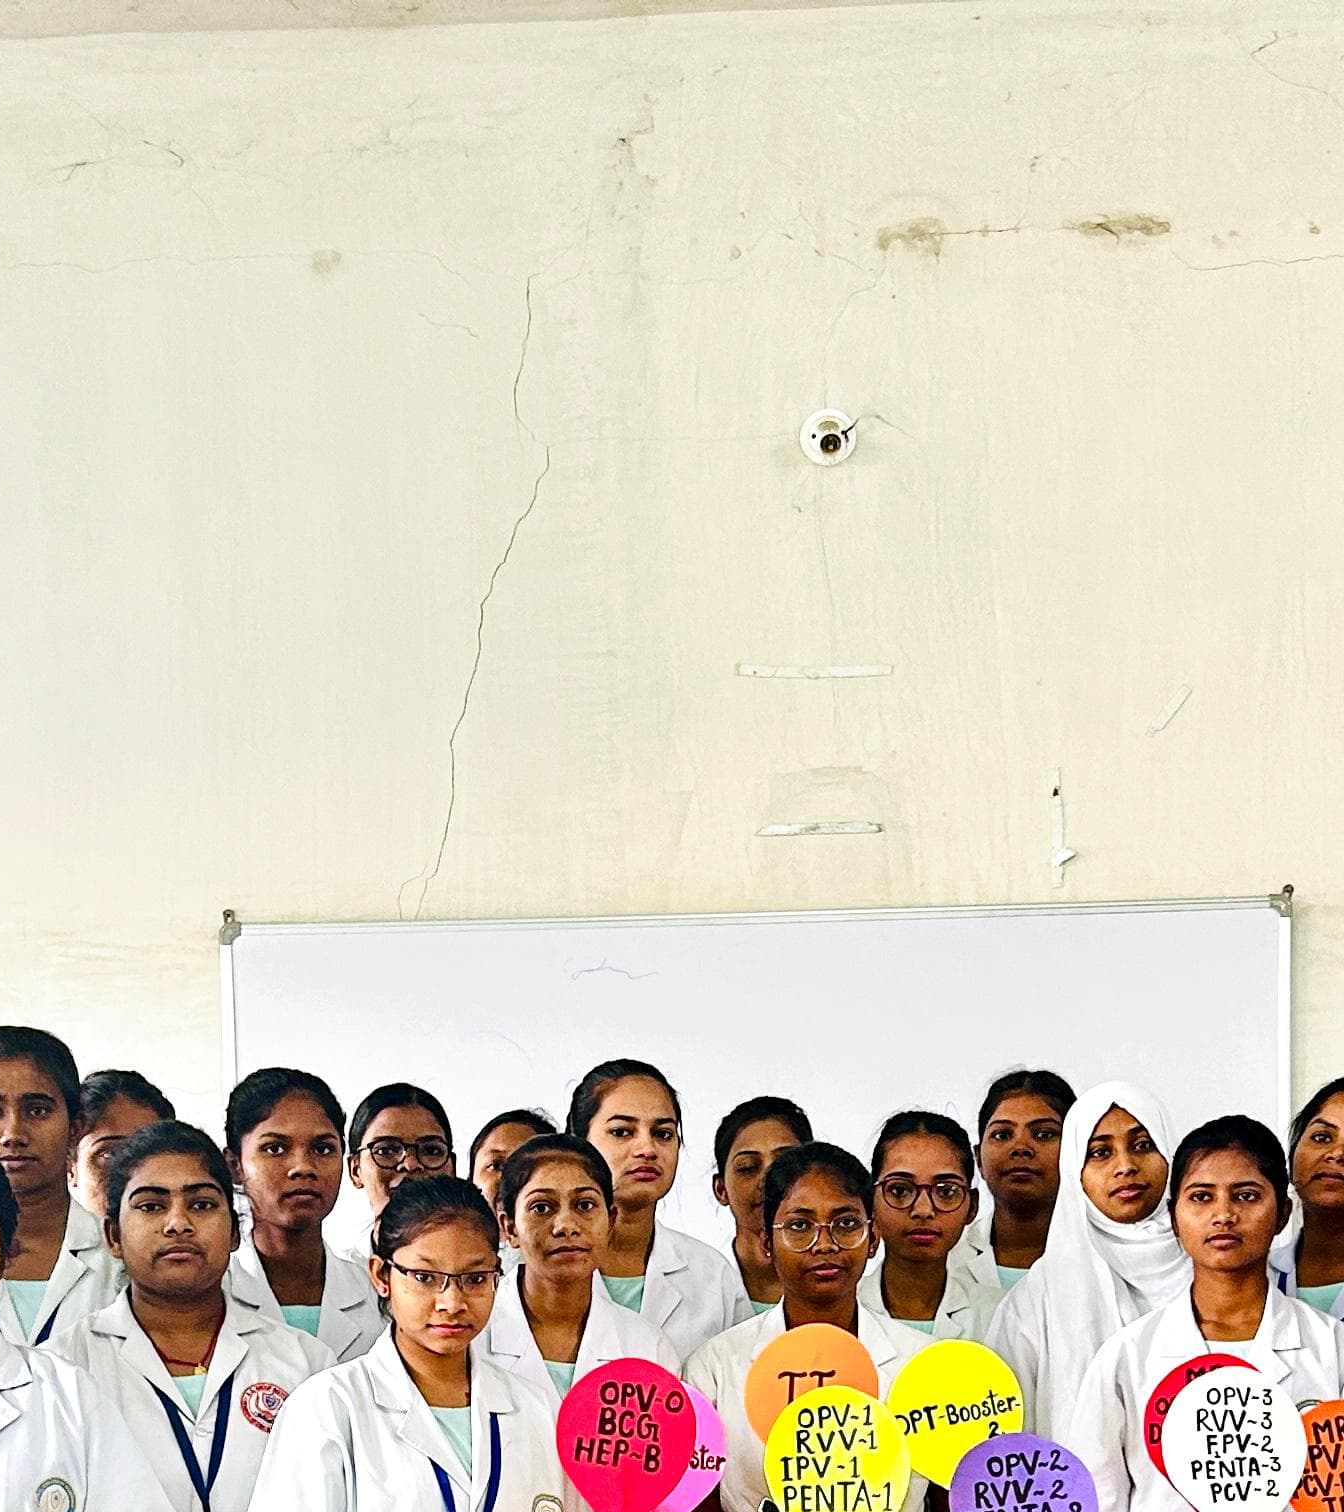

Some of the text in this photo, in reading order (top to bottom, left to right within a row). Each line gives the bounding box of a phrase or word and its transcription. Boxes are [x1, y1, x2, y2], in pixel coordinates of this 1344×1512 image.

[1206, 1386, 1272, 1407] OPV-3
[598, 1407, 659, 1442] BCG
[798, 1404, 873, 1429] OPV-1
[1196, 1408, 1272, 1432] RVV-3
[574, 1436, 661, 1472] HEP-B
[796, 1428, 877, 1454] RVV-1
[986, 1450, 1069, 1477] OPV-2
[1191, 1456, 1281, 1480] PENTA-3
[783, 1480, 893, 1512] PENTA-1
[974, 1478, 1068, 1509] RVV-2
[1210, 1479, 1279, 1503] PCV-2
